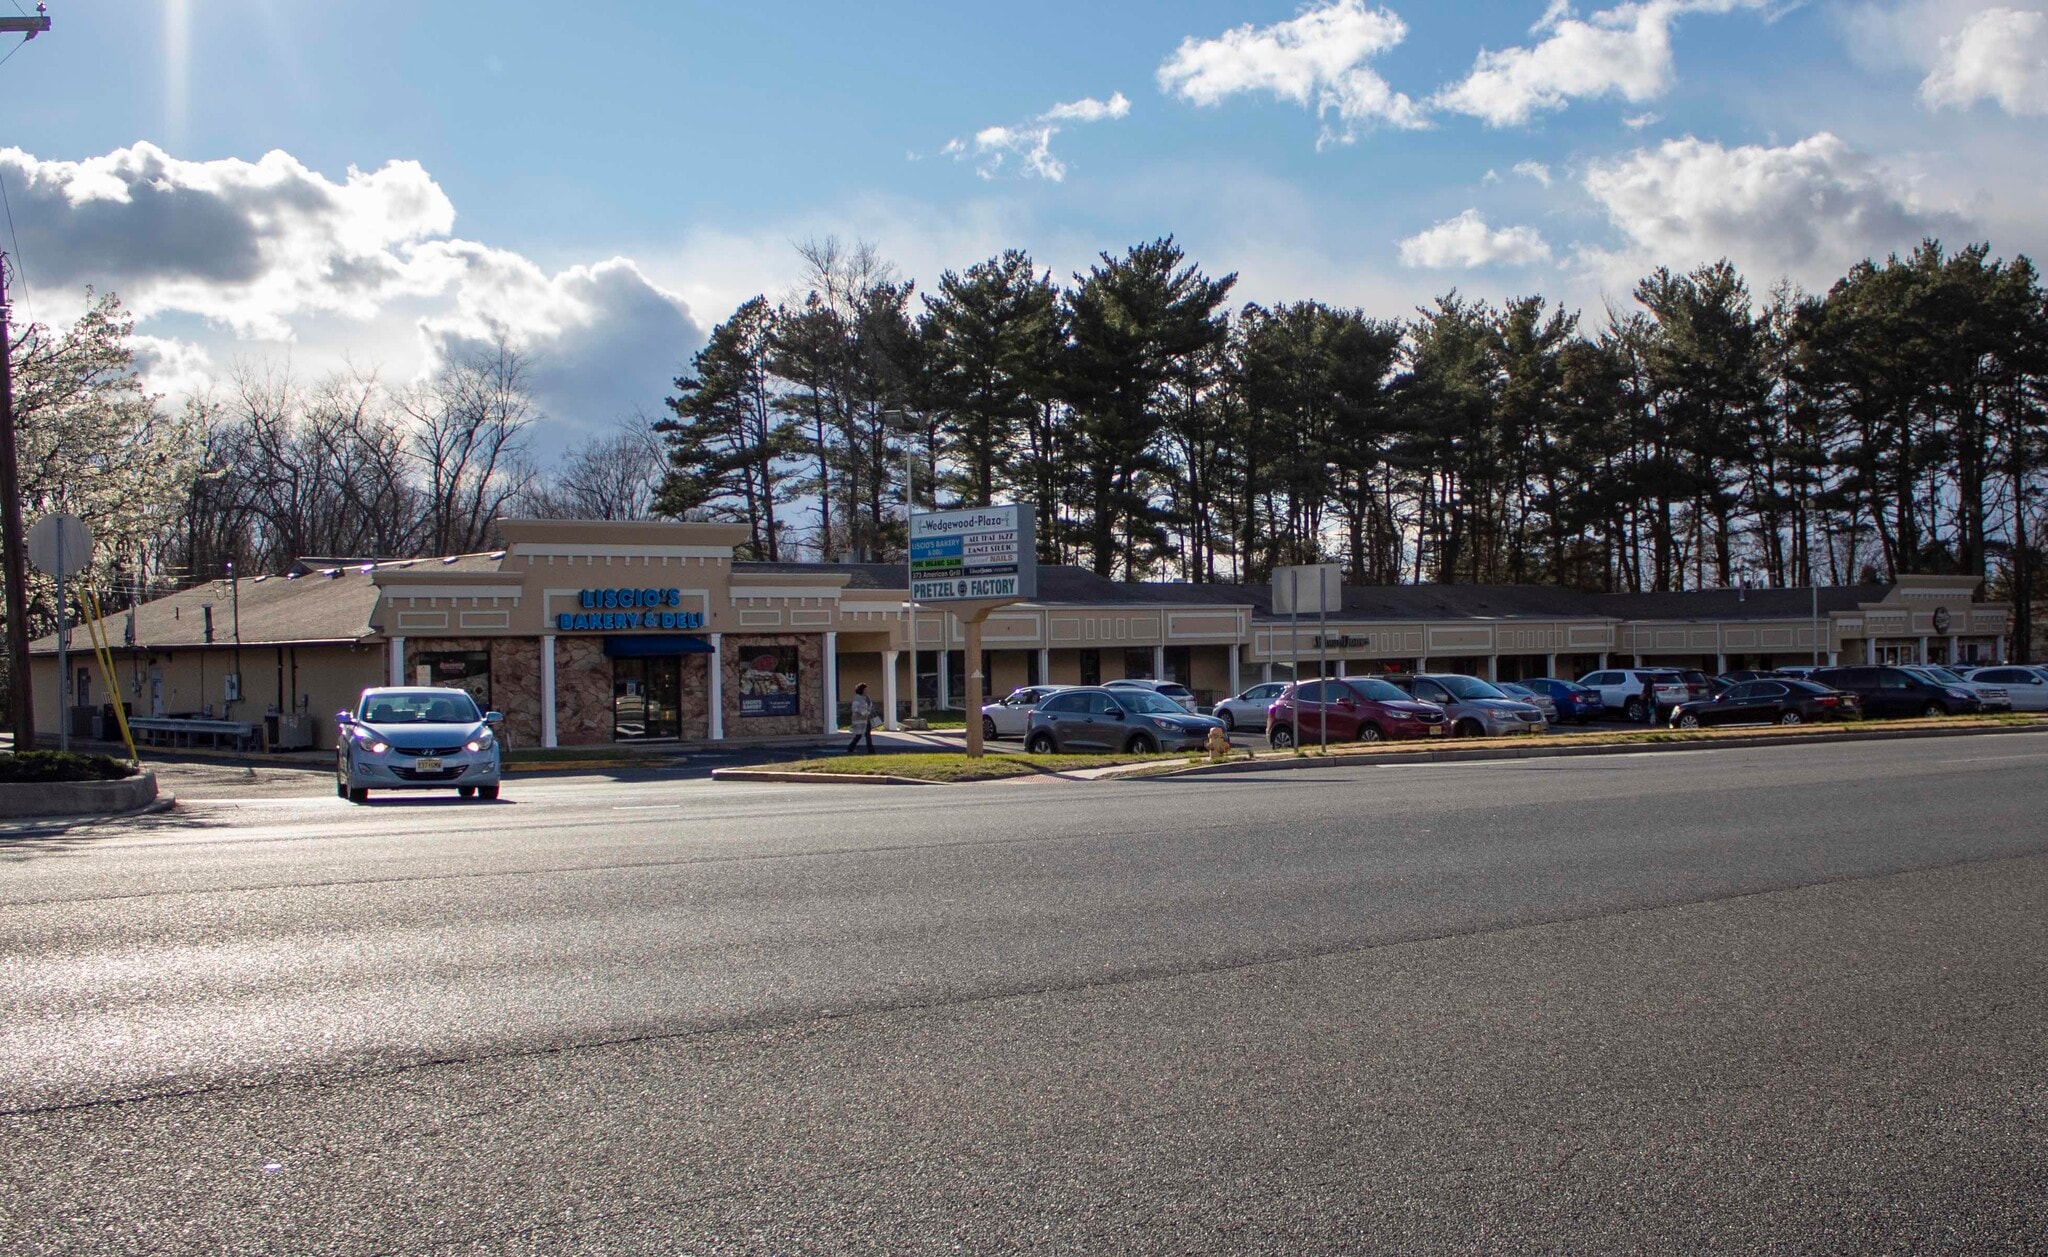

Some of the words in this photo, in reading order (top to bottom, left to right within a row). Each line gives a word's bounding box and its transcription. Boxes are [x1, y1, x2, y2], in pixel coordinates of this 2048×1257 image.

[990, 544, 1014, 552] STUDIO
[989, 554, 1013, 562] NAILS
[580, 588, 681, 608] LISCIO'S
[914, 582, 955, 598] PRETZEL
[971, 579, 1015, 596] FACTORY
[559, 612, 638, 630] BAKERY
[643, 611, 657, 628] &
[661, 612, 704, 629] DELI
